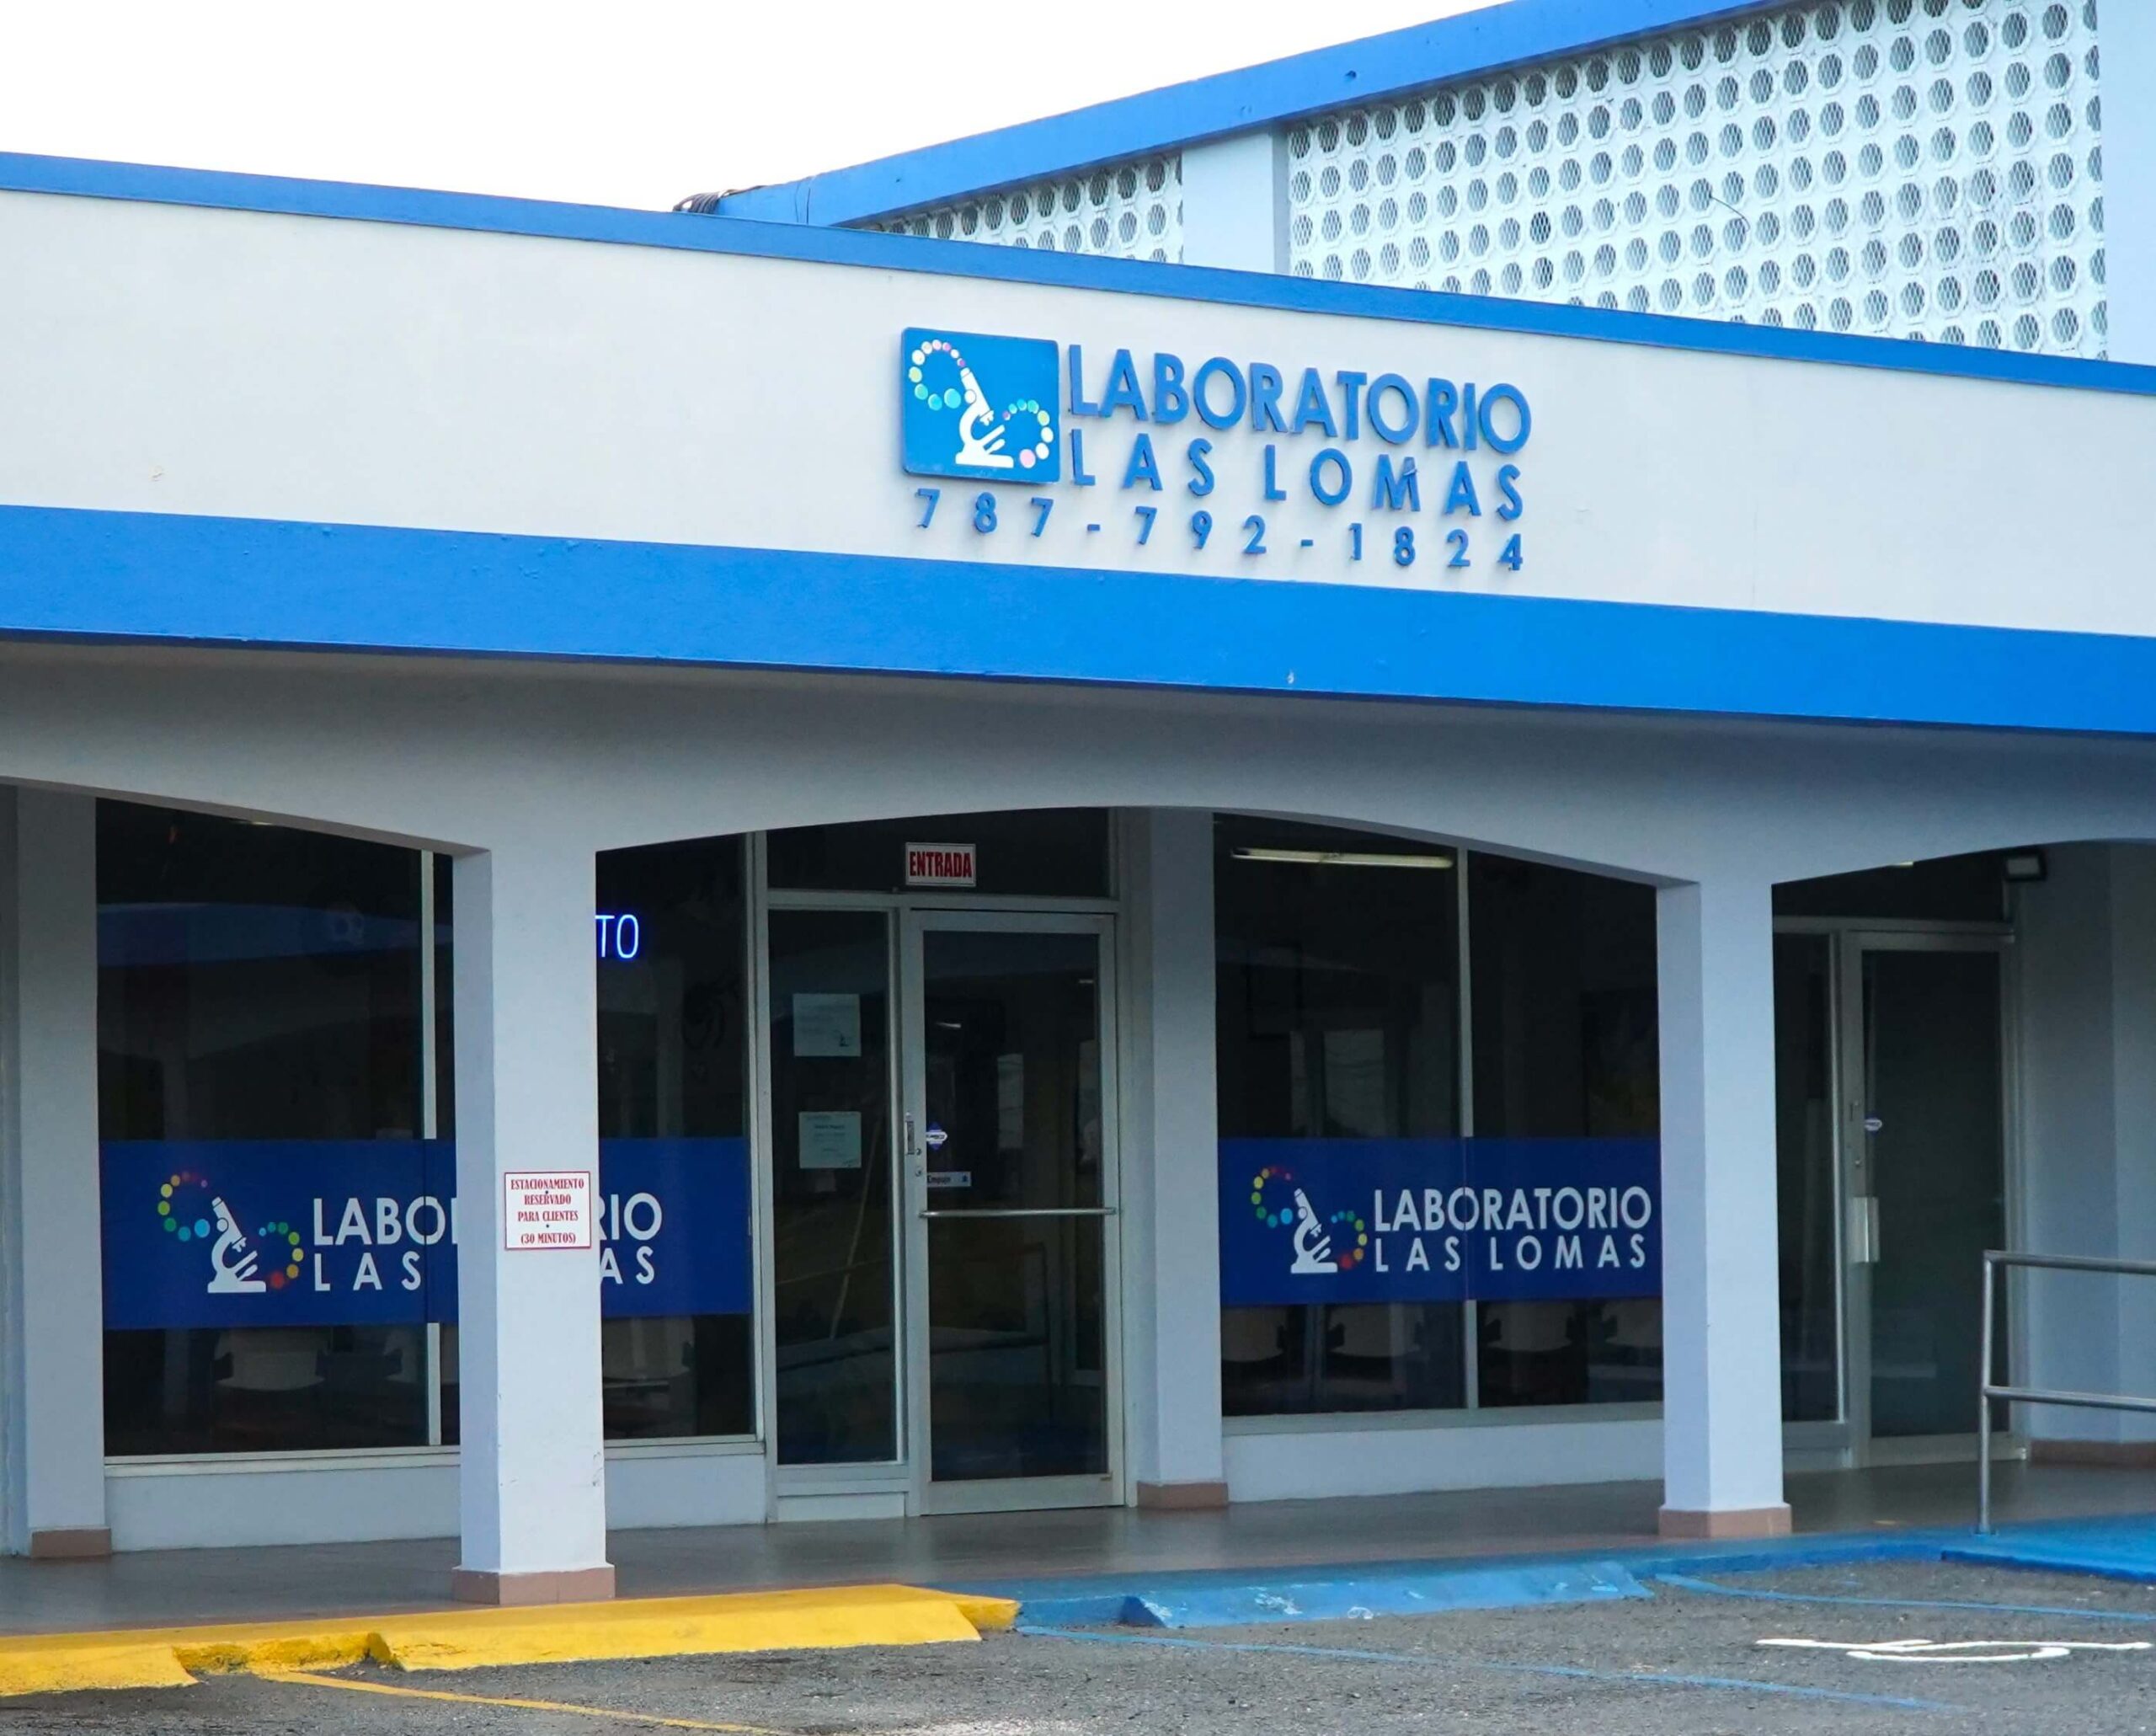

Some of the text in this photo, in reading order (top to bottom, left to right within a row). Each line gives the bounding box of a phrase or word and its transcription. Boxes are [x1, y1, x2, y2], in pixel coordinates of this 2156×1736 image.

[1069, 344, 1531, 455] LABORATORIO
[1070, 428, 1524, 521] LAS LOMAS
[916, 488, 1524, 571] 787-792-1824
[910, 851, 972, 878] ENTRADA
[510, 1178, 584, 1190] ESTACIONAMIENTO
[524, 1194, 571, 1205] RESERVADO
[518, 1210, 579, 1222] PARA CLIENTES
[1374, 1186, 1652, 1232] LABORATORIO
[520, 1232, 576, 1245] (30 MINUTOS)
[1375, 1233, 1646, 1273] LAS LOMAS
[313, 1251, 421, 1291] LAS
